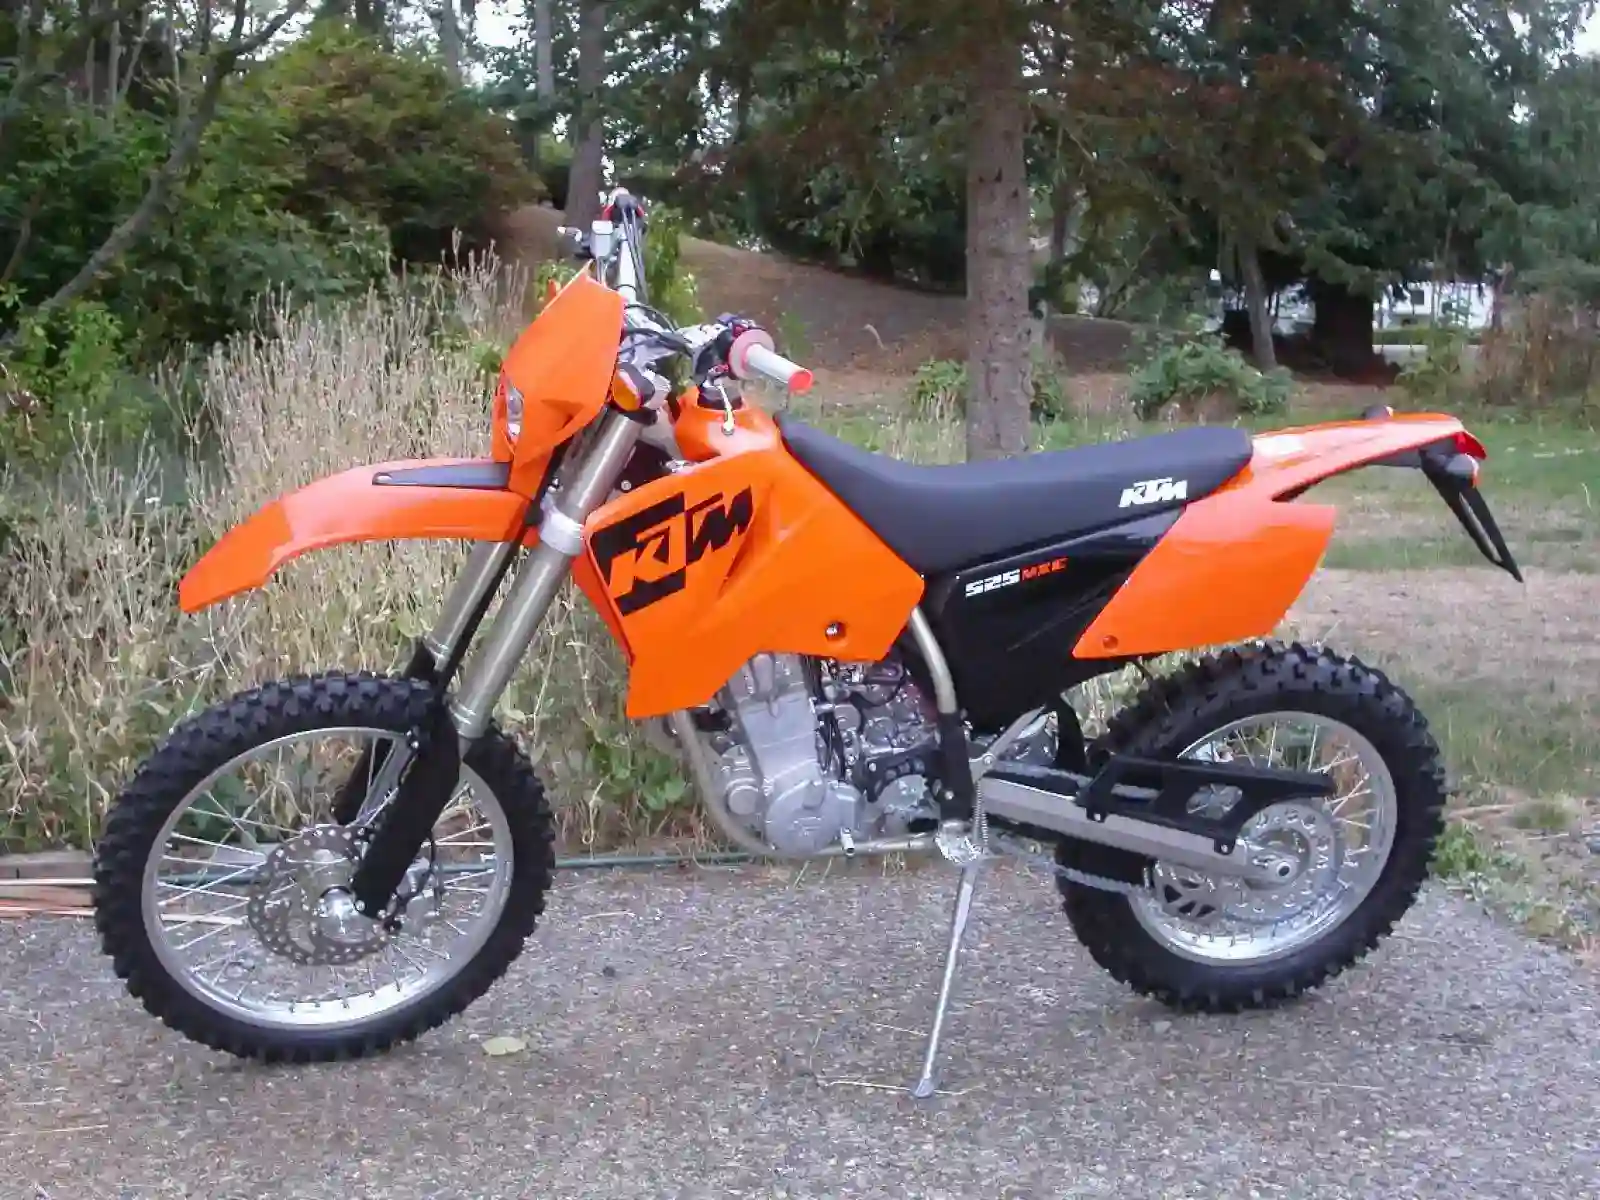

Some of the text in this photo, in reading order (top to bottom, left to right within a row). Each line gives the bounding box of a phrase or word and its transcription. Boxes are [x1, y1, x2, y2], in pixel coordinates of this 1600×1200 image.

[1118, 477, 1188, 508] KTM
[606, 484, 753, 600] KTM
[965, 568, 1020, 598] 525
